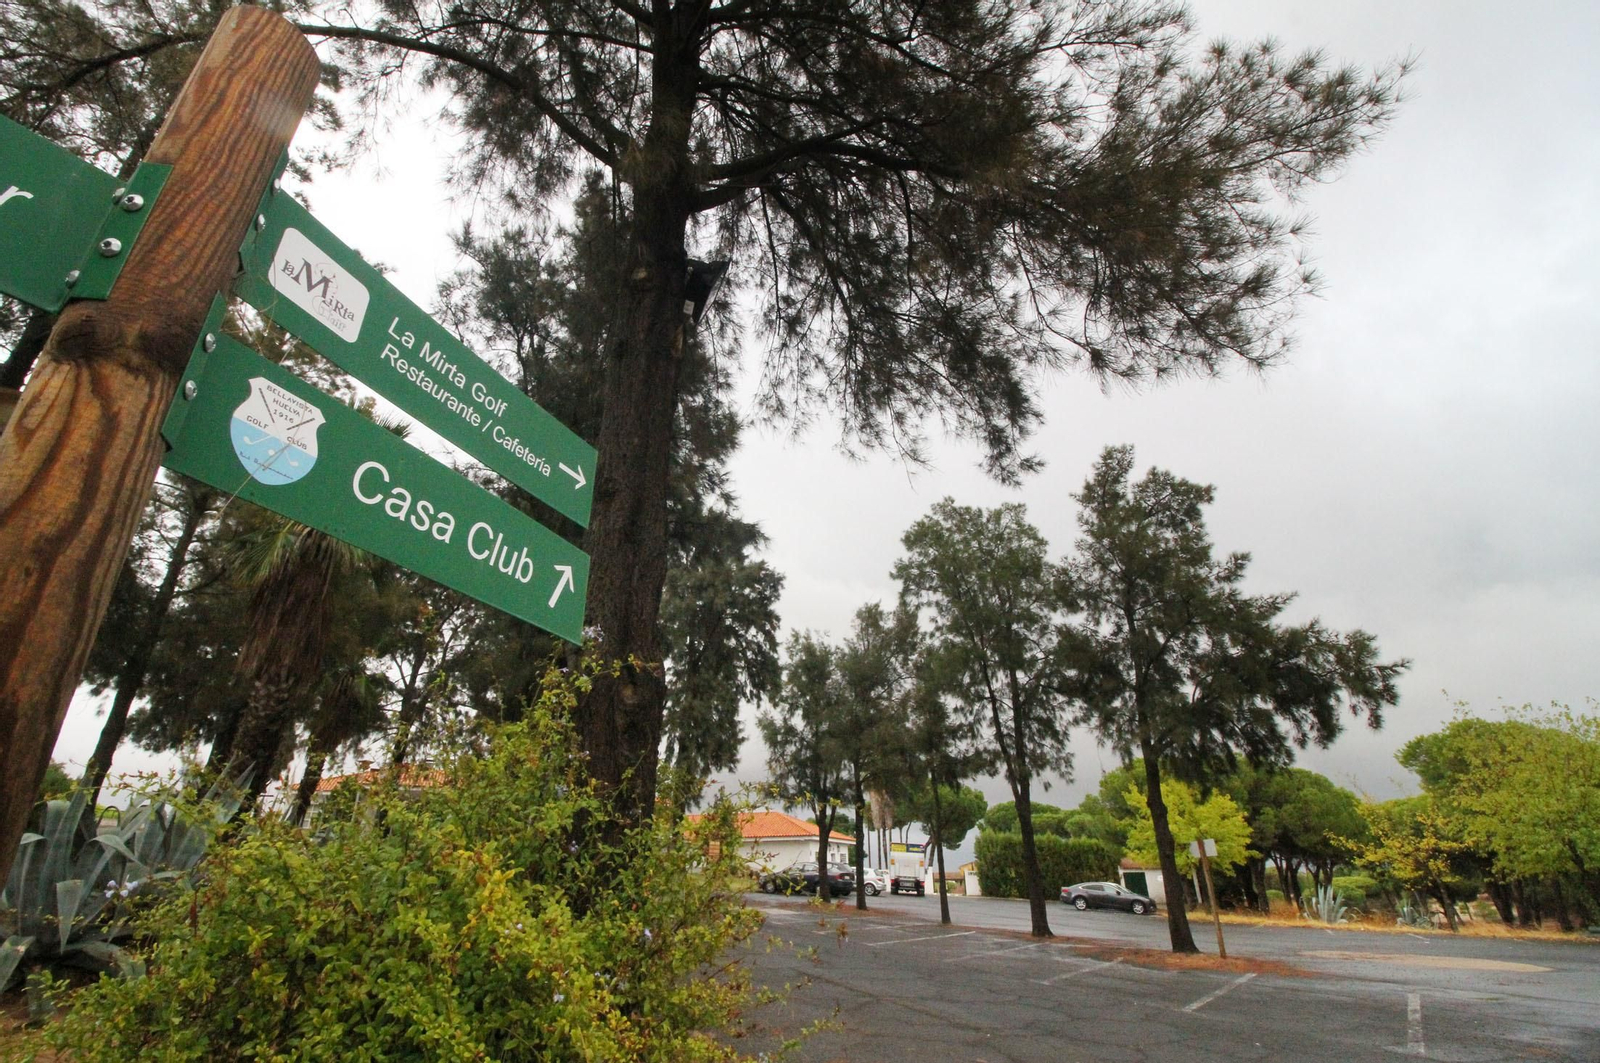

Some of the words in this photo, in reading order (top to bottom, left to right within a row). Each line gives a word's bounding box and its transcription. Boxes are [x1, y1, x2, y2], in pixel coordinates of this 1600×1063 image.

[266, 384, 313, 414] BELLAVISTA
[388, 317, 416, 349] La
[419, 341, 466, 389] Mirta
[471, 382, 508, 417] Golf
[246, 415, 269, 429] GOLF
[286, 436, 308, 450] CLUB
[272, 397, 300, 417] HUELVA
[380, 343, 481, 427] Restaurante
[482, 420, 492, 432] /
[492, 426, 551, 477] Cafetería
[352, 461, 456, 544] Casa
[467, 521, 534, 584] Club
